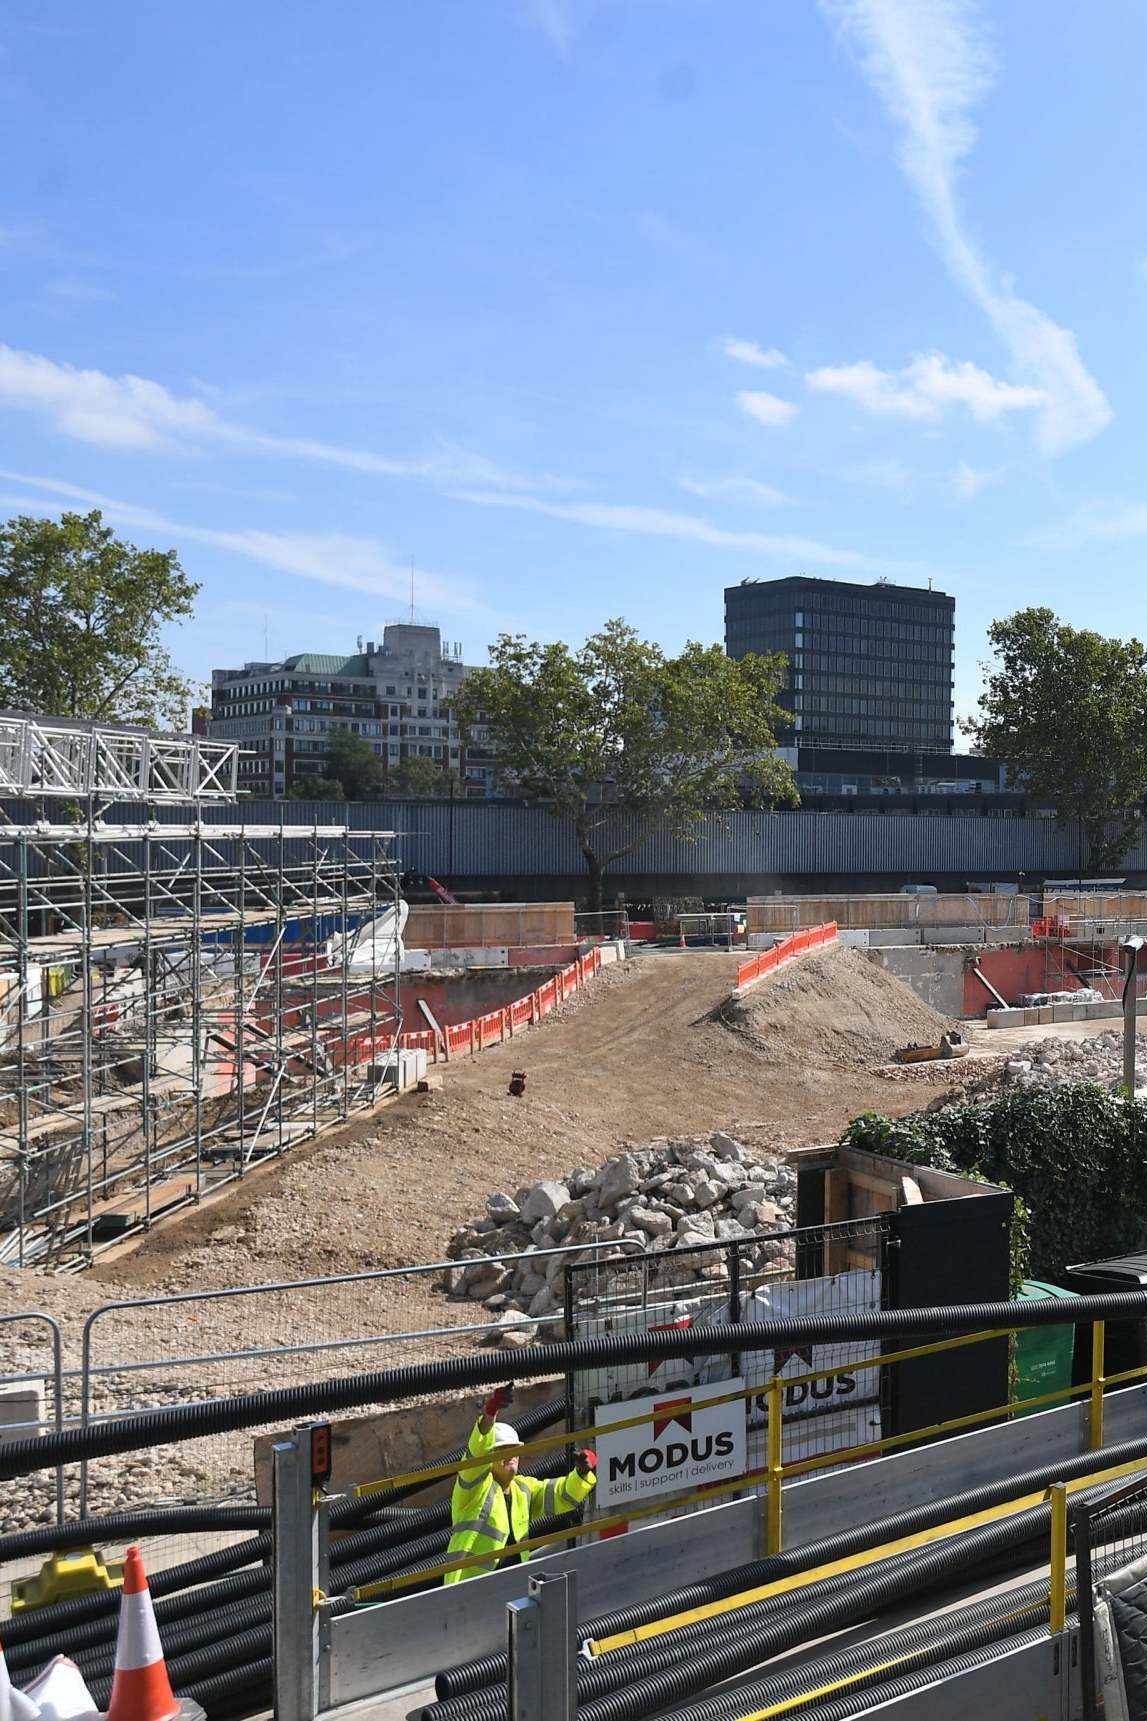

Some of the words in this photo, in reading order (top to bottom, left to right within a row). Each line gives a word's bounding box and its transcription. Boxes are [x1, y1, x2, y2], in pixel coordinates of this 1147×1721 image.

[608, 1482, 632, 1496] skills
[640, 1471, 683, 1489] support
[691, 1460, 735, 1476] delivery
[609, 1432, 734, 1482] MODUS
